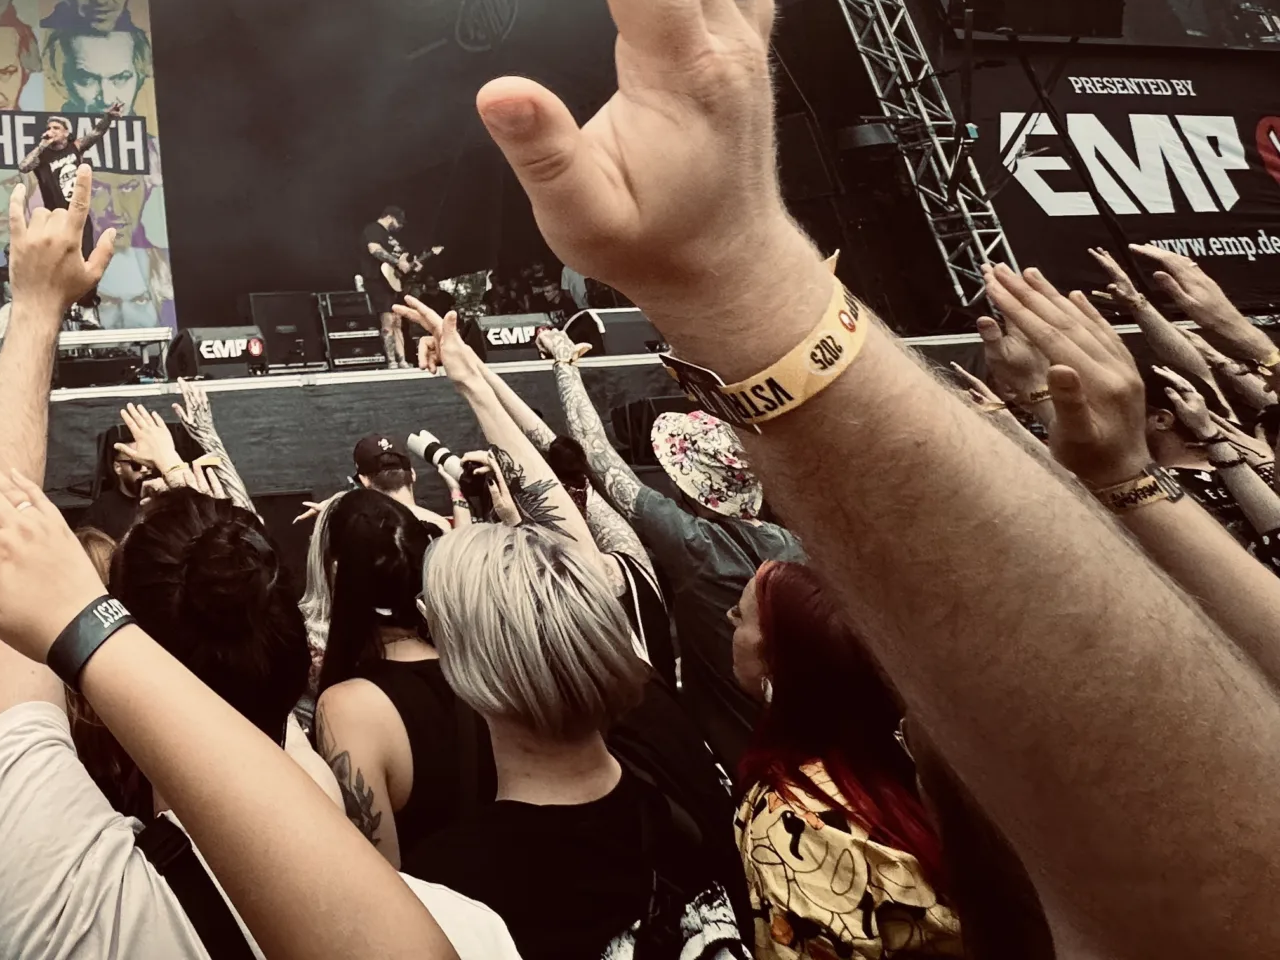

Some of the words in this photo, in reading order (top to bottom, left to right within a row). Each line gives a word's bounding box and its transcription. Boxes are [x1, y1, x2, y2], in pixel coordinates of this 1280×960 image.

[1067, 76, 1172, 96] PRESENTED
[1170, 79, 1197, 97] BY
[76, 116, 146, 171] ATH
[1000, 112, 1250, 217] EMP
[199, 338, 248, 359] EMP
[487, 325, 536, 346] EMP
[809, 334, 843, 370] 2025
